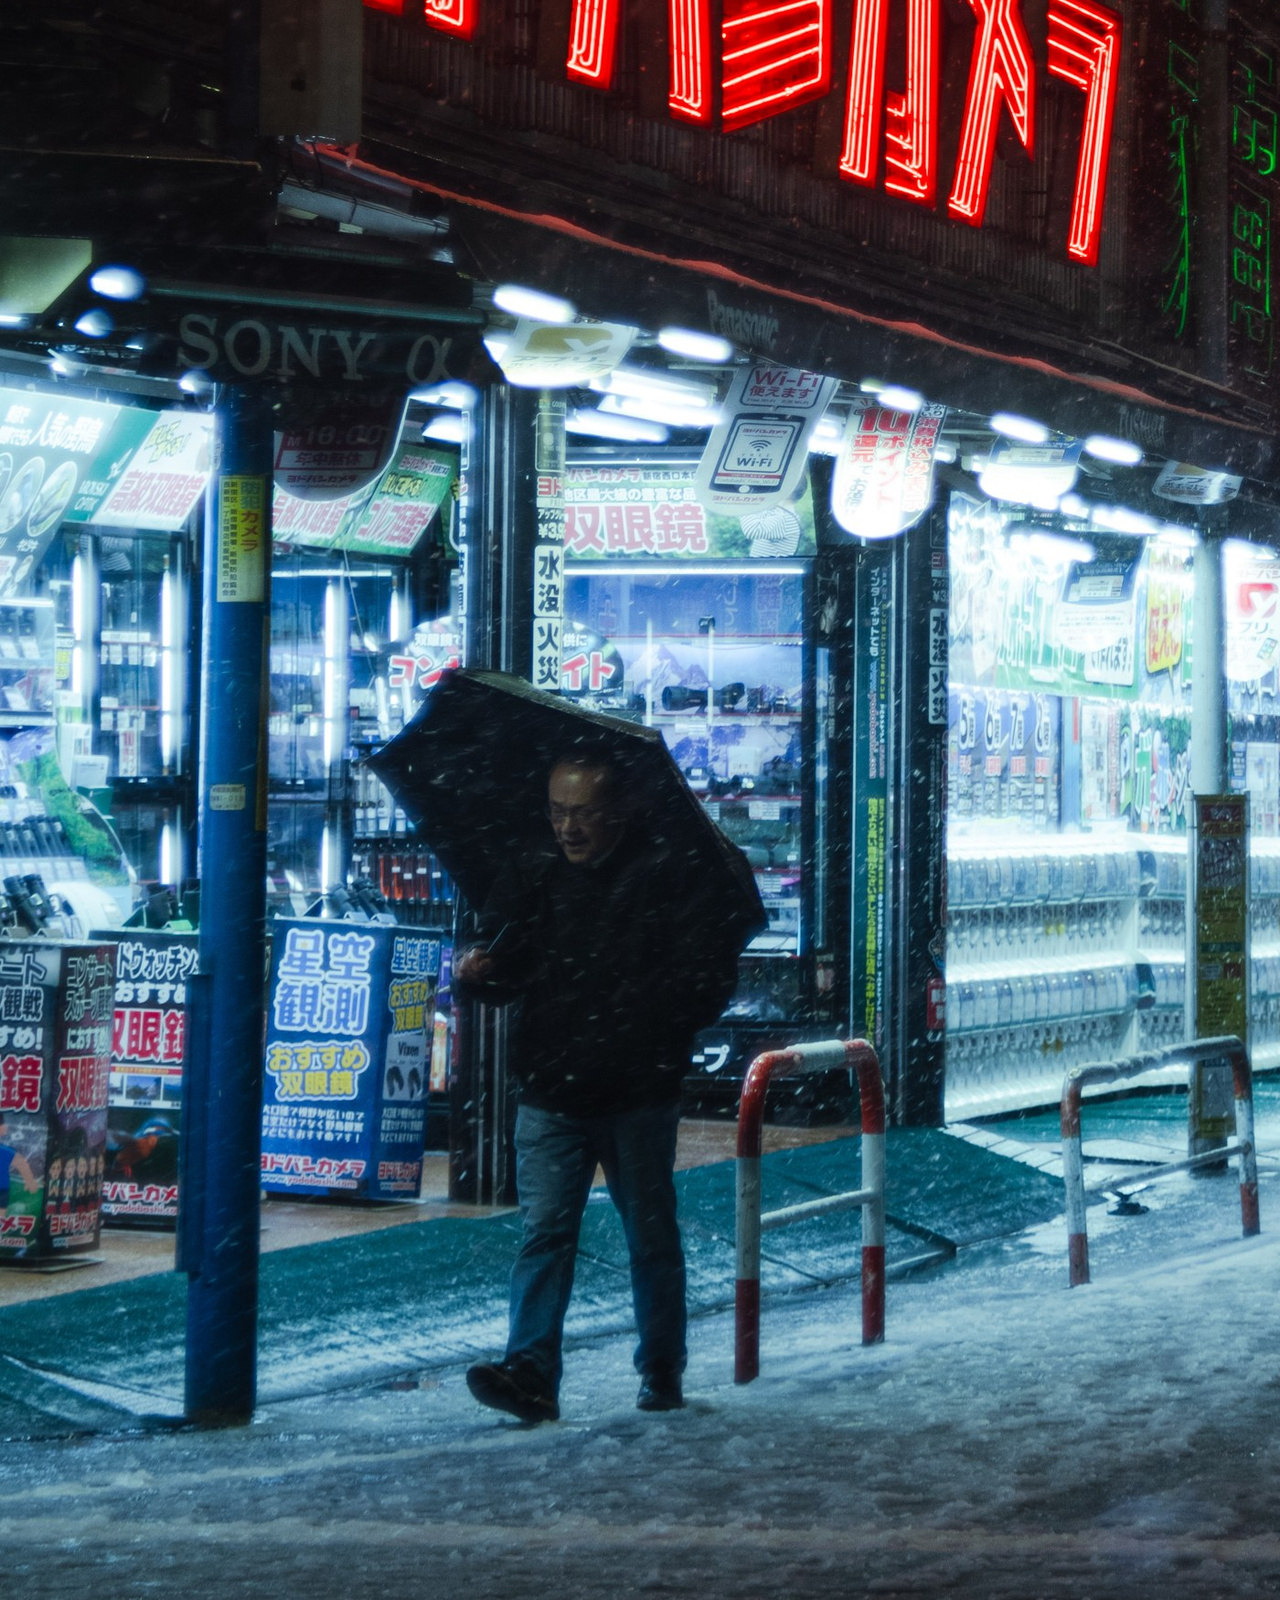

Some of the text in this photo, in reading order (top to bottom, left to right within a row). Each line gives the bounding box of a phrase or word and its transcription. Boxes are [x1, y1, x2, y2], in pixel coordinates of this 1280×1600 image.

[706, 288, 780, 353] Panasonic
[176, 313, 457, 385] SONY α
[750, 386, 814, 399] 使えます
[755, 369, 819, 388] Wi-Fi
[286, 474, 358, 484] ヨドバシカメラ
[240, 481, 261, 552] 防犯カメラ
[538, 549, 561, 614] 水没
[537, 622, 560, 685] 火災
[67, 954, 114, 991] コンサート
[277, 928, 376, 987] 星空
[0, 985, 45, 1023] 観戦
[273, 978, 372, 1037] 観測
[265, 1038, 371, 1077] おすすめ
[276, 1067, 359, 1103] 双眼鏡
